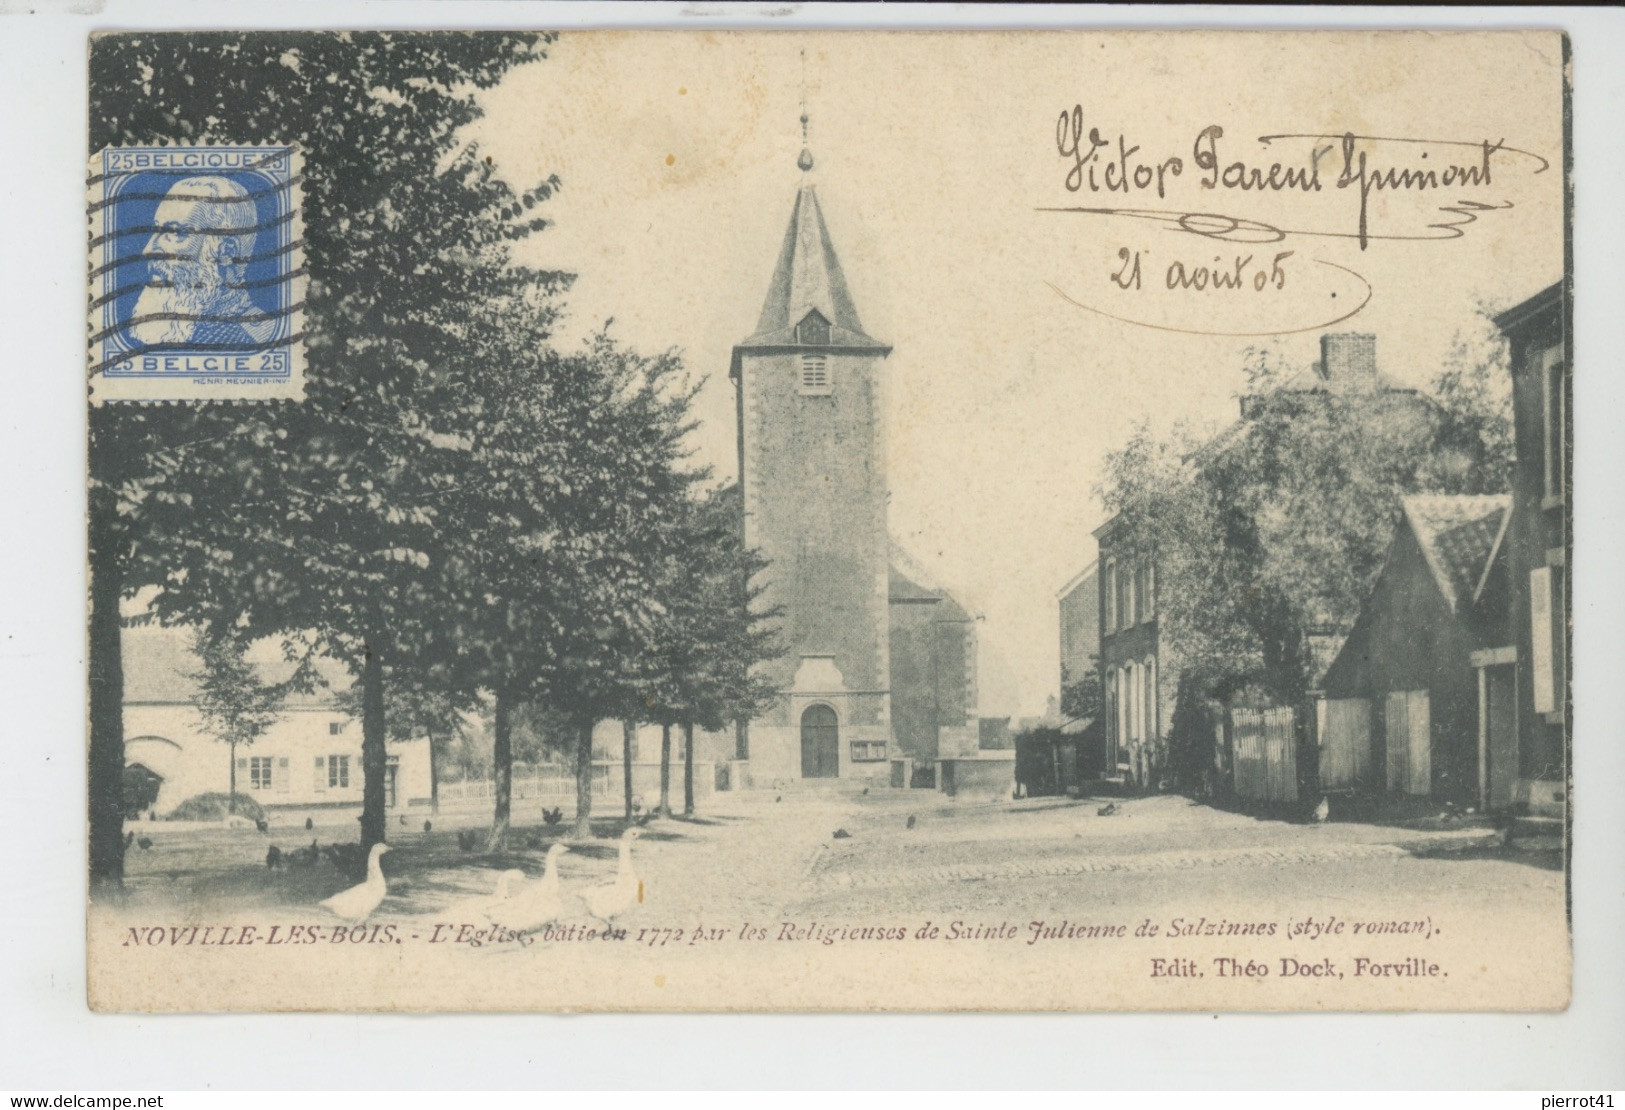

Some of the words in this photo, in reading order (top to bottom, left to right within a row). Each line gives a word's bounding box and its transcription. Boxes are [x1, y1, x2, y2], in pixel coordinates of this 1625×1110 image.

[135, 153, 257, 169] BELGIQUE
[1056, 104, 1183, 198] Victor
[1194, 125, 1334, 191] Parent
[1110, 246, 1143, 291] 21
[142, 357, 251, 371] BELGIE
[260, 354, 284, 371] 25
[122, 924, 402, 947] NOVILLE-LES-BOIS.
[636, 927, 685, 947] 1772
[688, 927, 731, 946] par
[738, 922, 768, 941] les
[777, 921, 907, 945] Religieuses
[915, 920, 940, 940] de
[945, 920, 1018, 941] Sainte
[1026, 920, 1127, 945] Julienne
[1134, 918, 1160, 938] de
[1166, 917, 1278, 938] Salzinnes
[1286, 916, 1345, 940] (style
[1353, 916, 1441, 939] roman).
[1213, 956, 1269, 977] Théo
[1279, 957, 1345, 980] Dock,
[1353, 956, 1449, 977] Forville.
